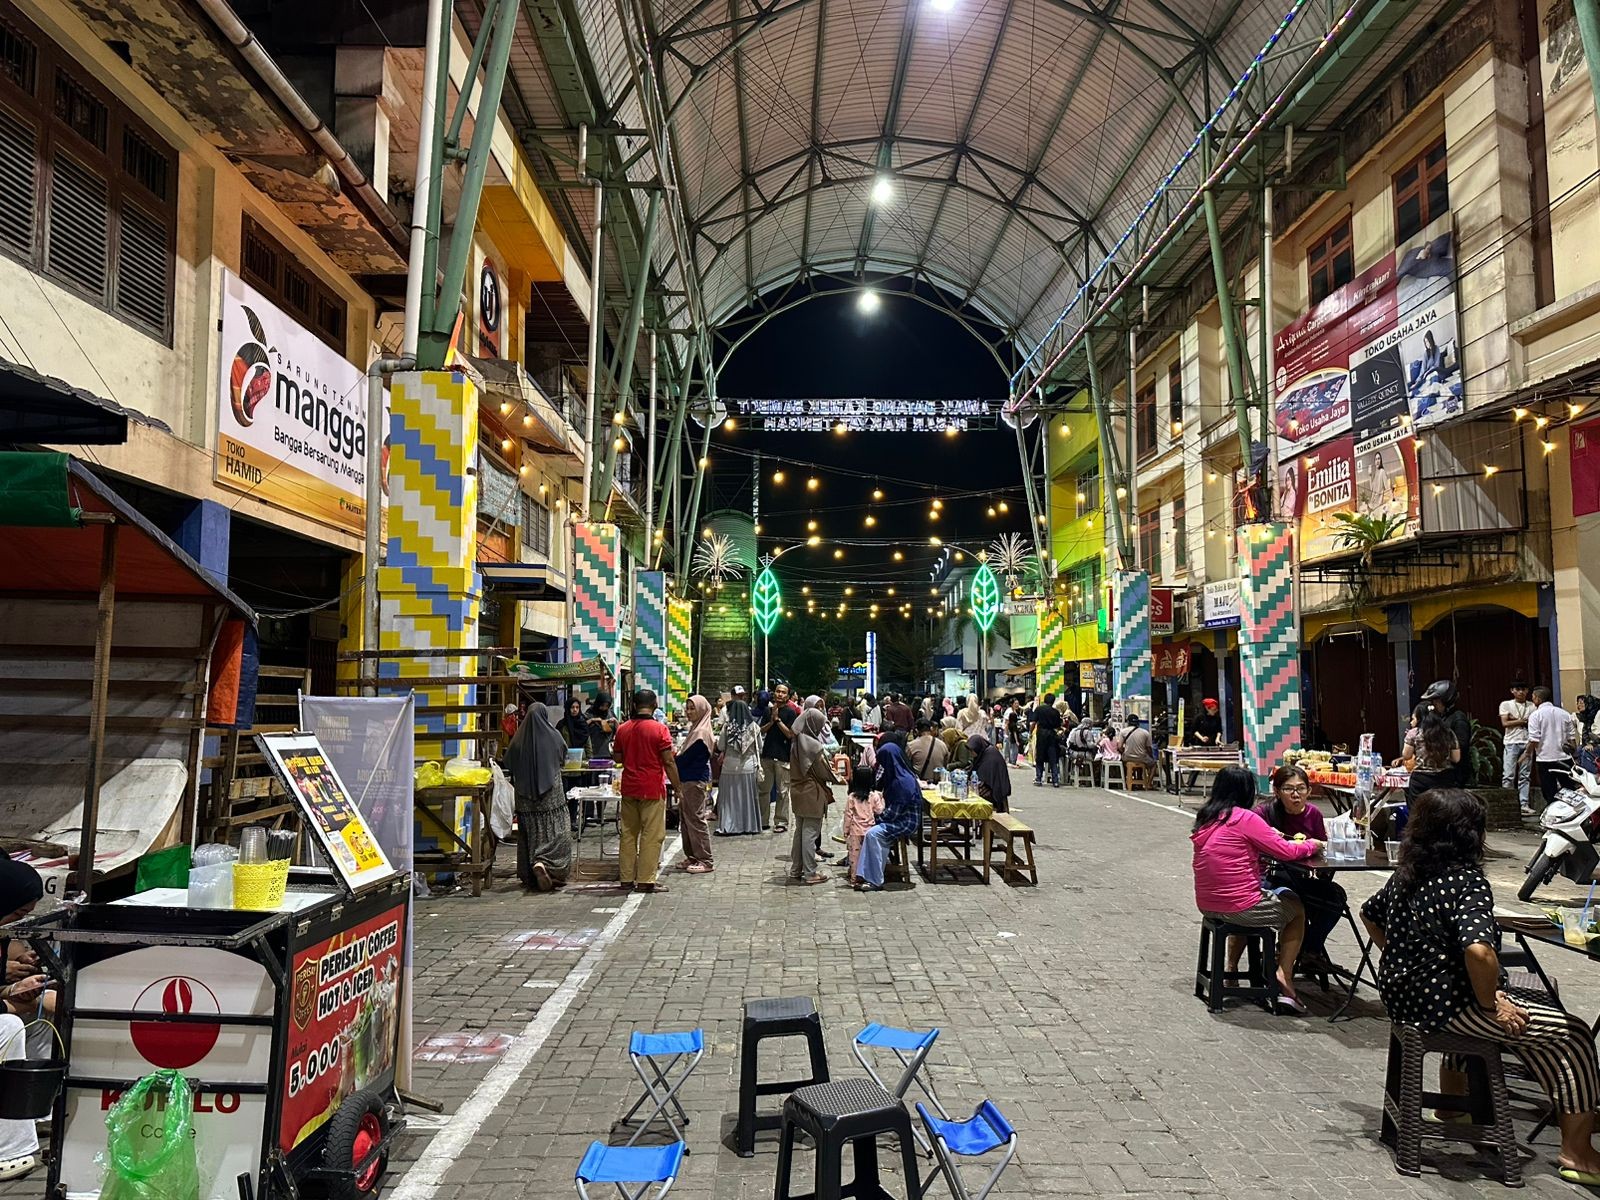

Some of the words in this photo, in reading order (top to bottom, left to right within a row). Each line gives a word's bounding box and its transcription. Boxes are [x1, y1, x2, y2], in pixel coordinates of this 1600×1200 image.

[1364, 340, 1385, 358] TOKO
[1386, 323, 1414, 346] USAHA
[1415, 309, 1437, 330] JAYA
[277, 352, 328, 396] SARUNG
[275, 370, 365, 460] mangga
[1295, 423, 1309, 436] Toko
[1309, 413, 1329, 429] Usaha
[1330, 404, 1346, 420] Jaya
[226, 440, 245, 458] TOKO
[274, 426, 302, 453] Bangga
[303, 441, 339, 474] Bersarung
[340, 463, 365, 485] Mangga
[1356, 443, 1371, 453] TOKO
[1372, 434, 1391, 447] USAHA
[1393, 427, 1409, 440] JAYA
[226, 455, 262, 484] HAMID
[1308, 456, 1350, 493] Emilia
[1313, 482, 1349, 509] BONITA
[319, 937, 366, 985] PERISAY
[367, 921, 398, 959] COFFEE
[317, 983, 341, 1020] HOT
[342, 978, 351, 1005] &
[352, 965, 375, 999] ICED
[288, 1034, 340, 1098] 5.000
